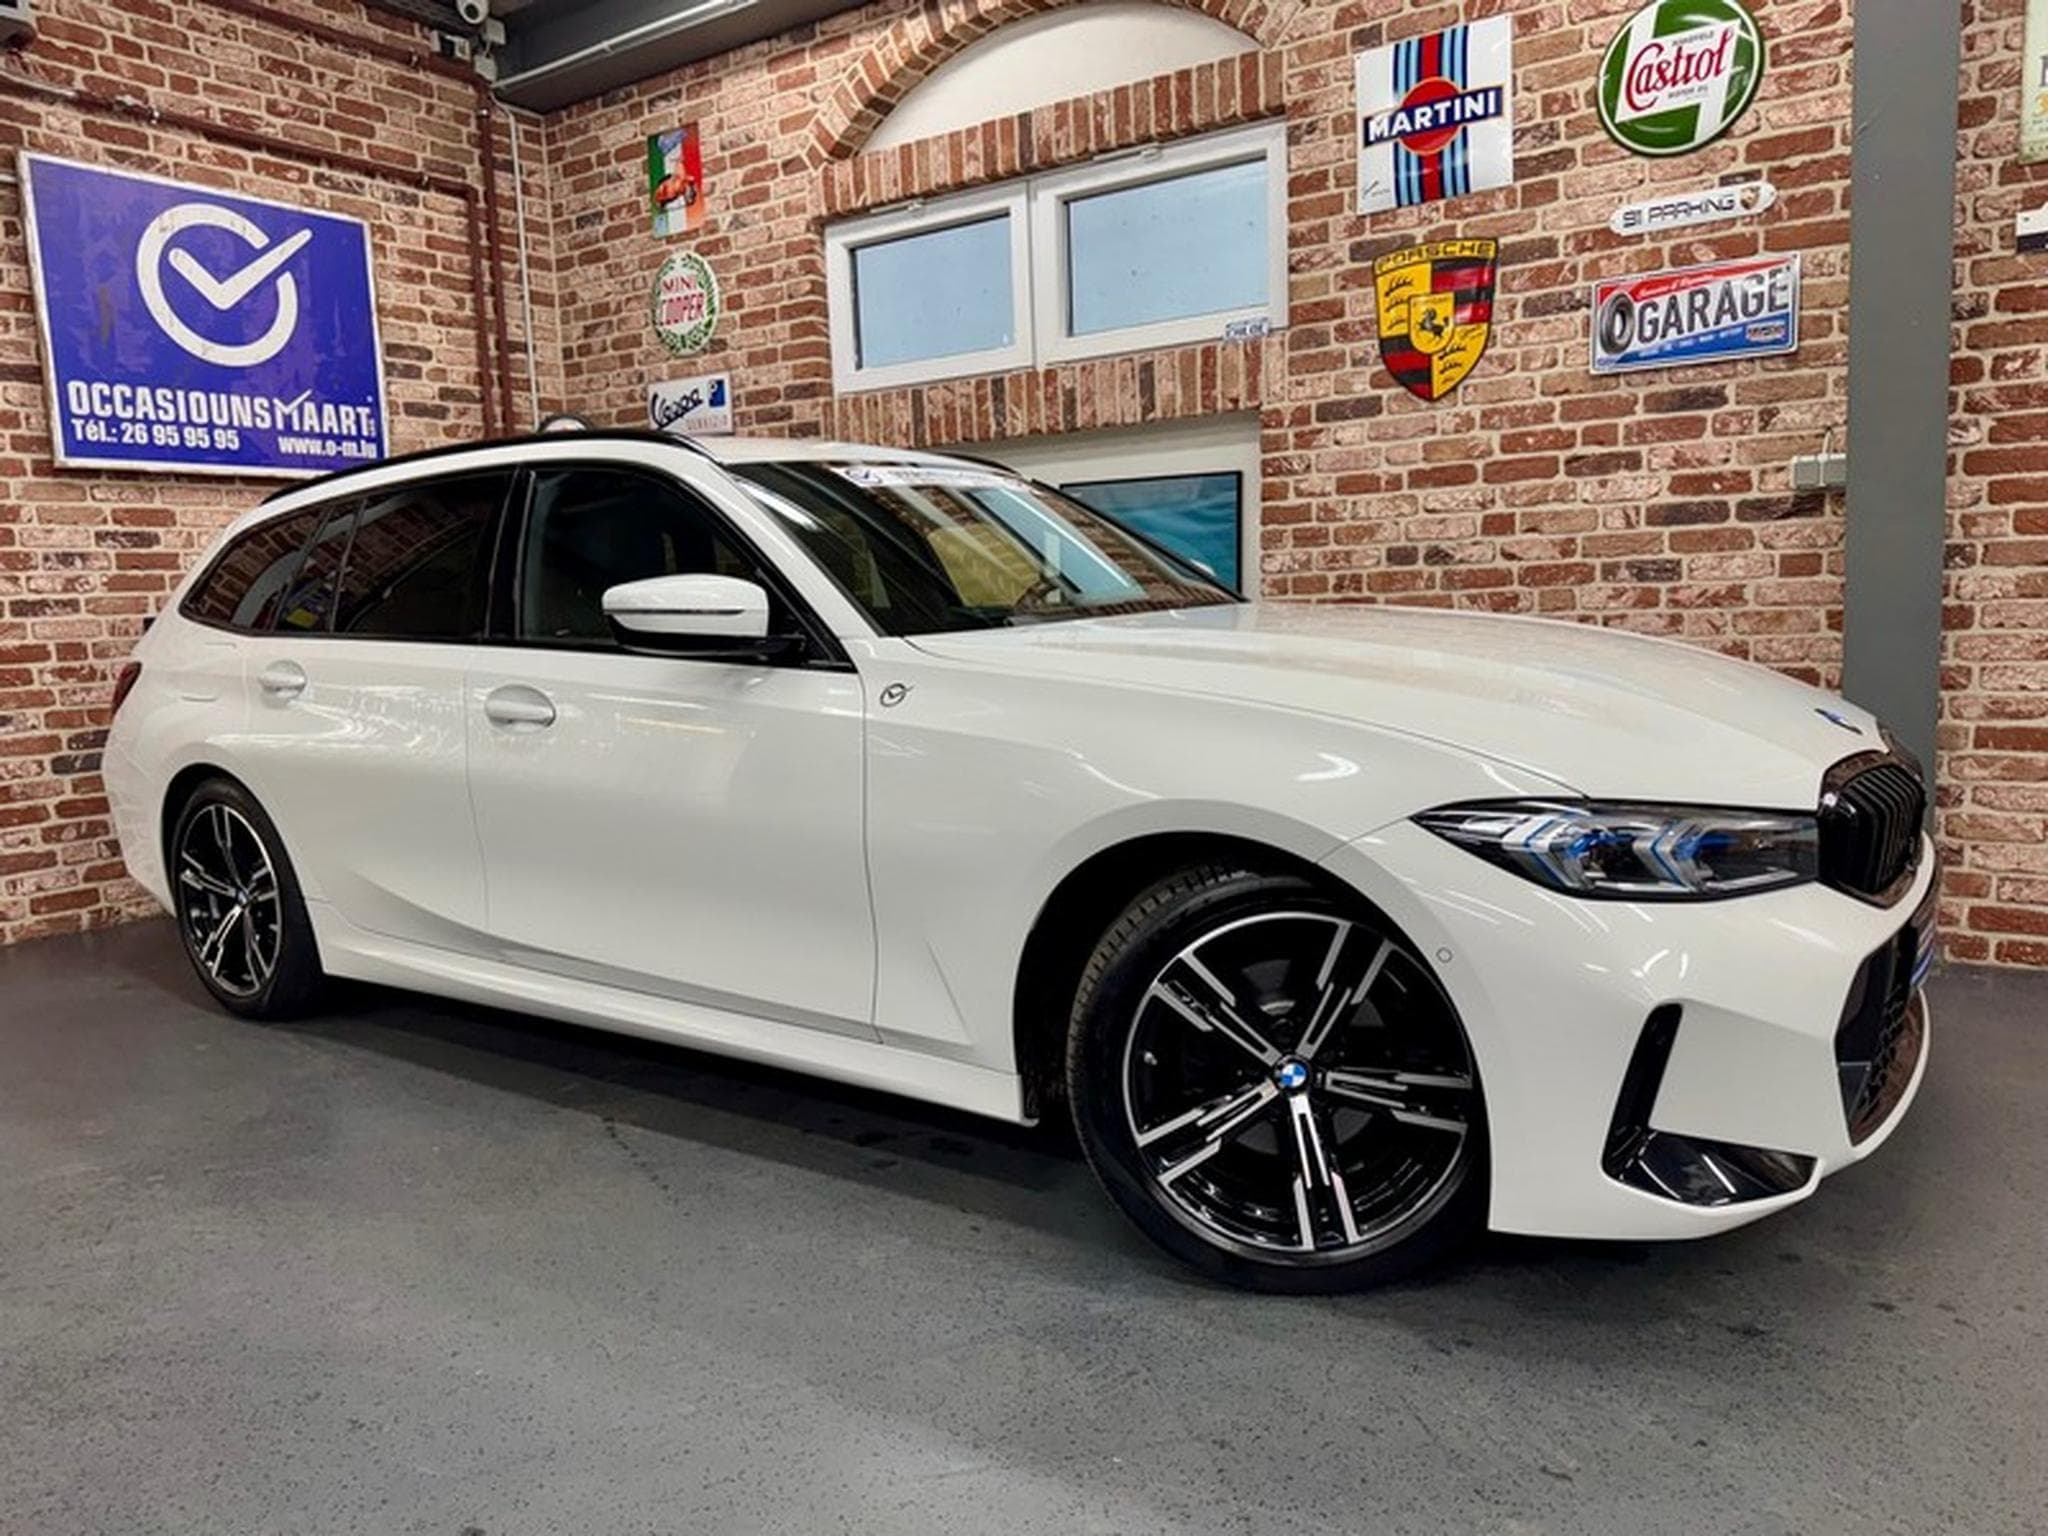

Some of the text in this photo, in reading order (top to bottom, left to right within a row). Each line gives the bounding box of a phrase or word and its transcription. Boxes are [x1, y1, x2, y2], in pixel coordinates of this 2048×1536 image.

[1626, 27, 1734, 112] Castrol
[1368, 90, 1497, 142] MARTINI
[1648, 193, 1736, 223] PARKING
[1377, 241, 1493, 272] PORSCHE
[660, 275, 698, 295] MINI
[656, 292, 705, 327] COOPER
[1637, 267, 1791, 345] GARAGE
[651, 388, 704, 429] Vespa
[121, 422, 149, 444] 26
[152, 424, 181, 447] 95
[184, 426, 211, 449] 95
[213, 428, 240, 451] 95
